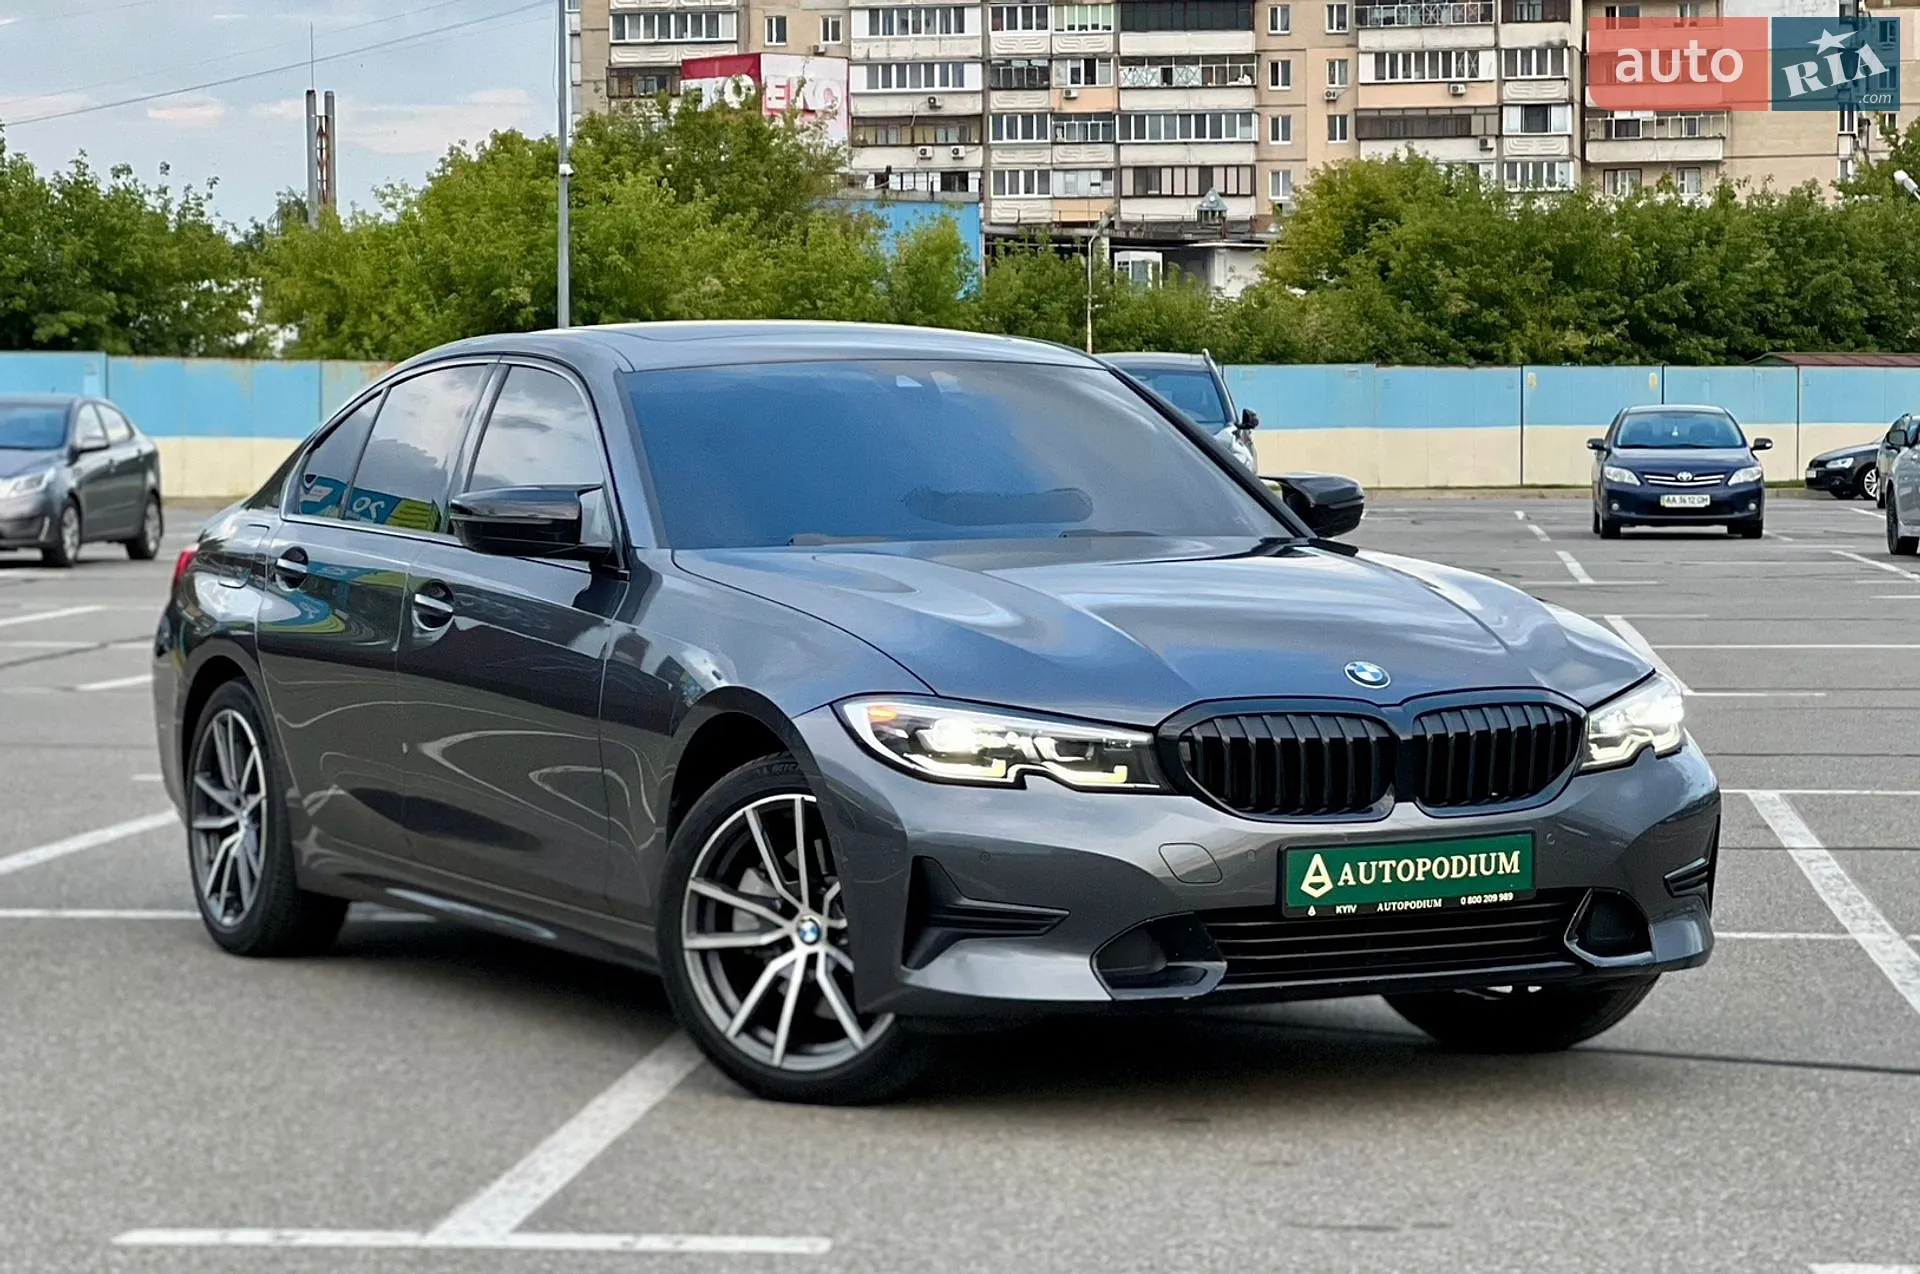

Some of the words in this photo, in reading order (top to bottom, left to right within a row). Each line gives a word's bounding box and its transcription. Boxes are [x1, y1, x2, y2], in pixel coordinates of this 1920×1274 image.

[1338, 850, 1521, 886] AUTOPODIUM
[1335, 904, 1357, 914] KYIV
[1376, 898, 1442, 912] AUTOPODIUM
[1483, 893, 1498, 903] 209
